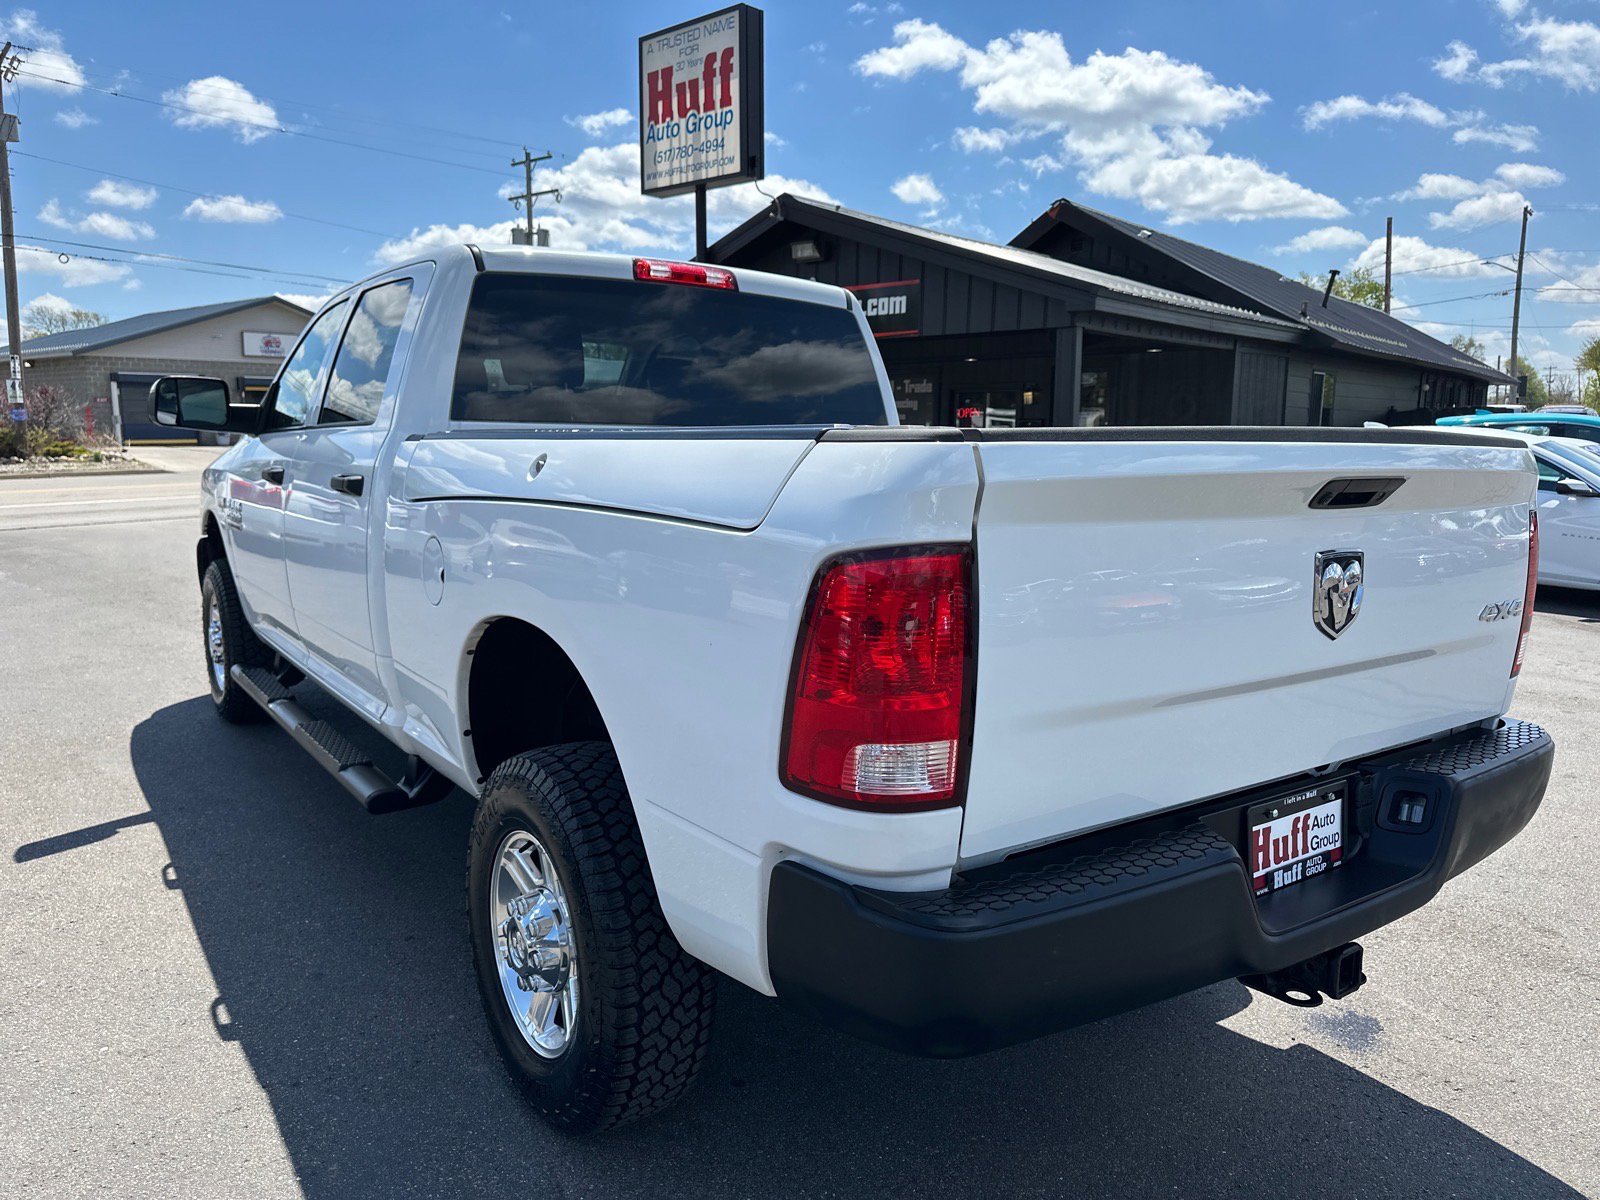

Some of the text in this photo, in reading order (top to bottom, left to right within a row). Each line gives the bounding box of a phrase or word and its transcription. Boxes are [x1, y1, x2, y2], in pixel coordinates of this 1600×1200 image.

[646, 16, 735, 56] A TRUSTED NAME
[679, 43, 700, 58] FOR
[647, 46, 734, 126] Huff
[646, 108, 734, 144] Auto Group
[654, 137, 725, 166] (517)780-4994
[859, 295, 907, 317] .com
[957, 407, 981, 418] OPEN
[1252, 813, 1336, 874] Huff Auto
[1310, 831, 1340, 851] Group
[1273, 855, 1323, 890] Huff AUTO
[1305, 862, 1327, 877] GROUP
